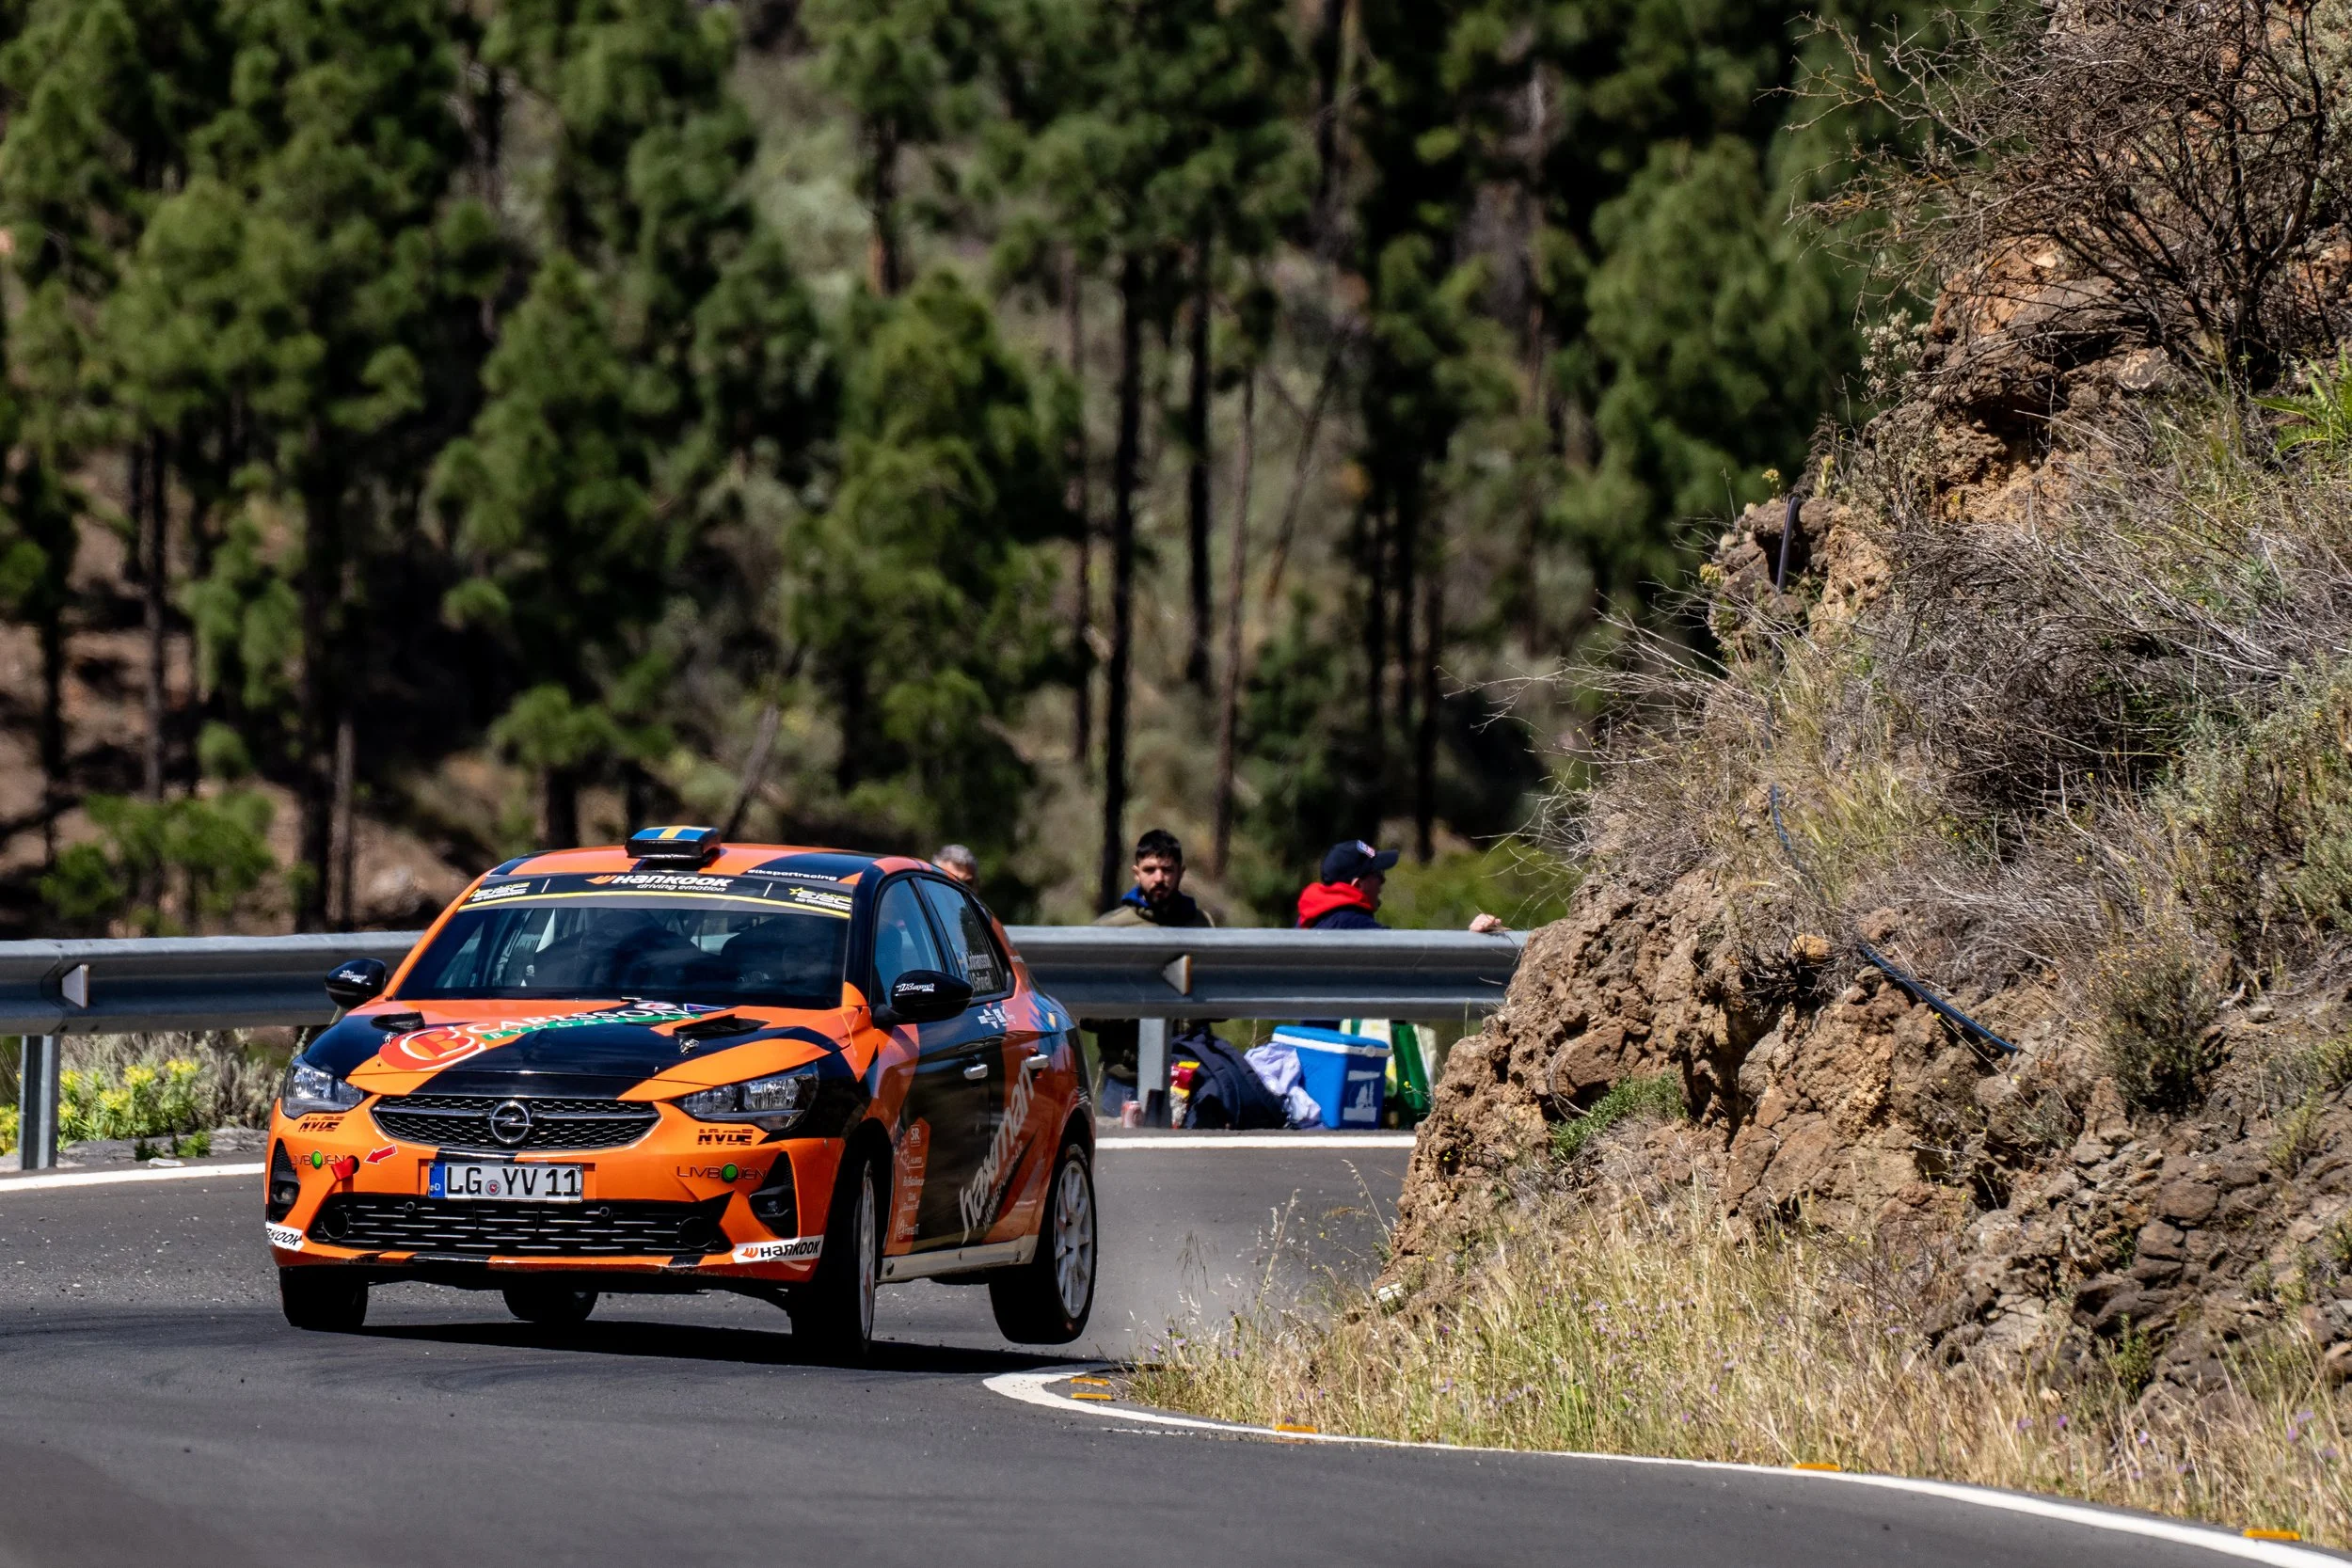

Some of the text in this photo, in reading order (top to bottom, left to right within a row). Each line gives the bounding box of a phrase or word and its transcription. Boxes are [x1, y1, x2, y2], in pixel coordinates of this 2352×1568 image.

[467, 1008, 691, 1034] CARLSSON
[435, 1166, 580, 1196] D LG YV 11
